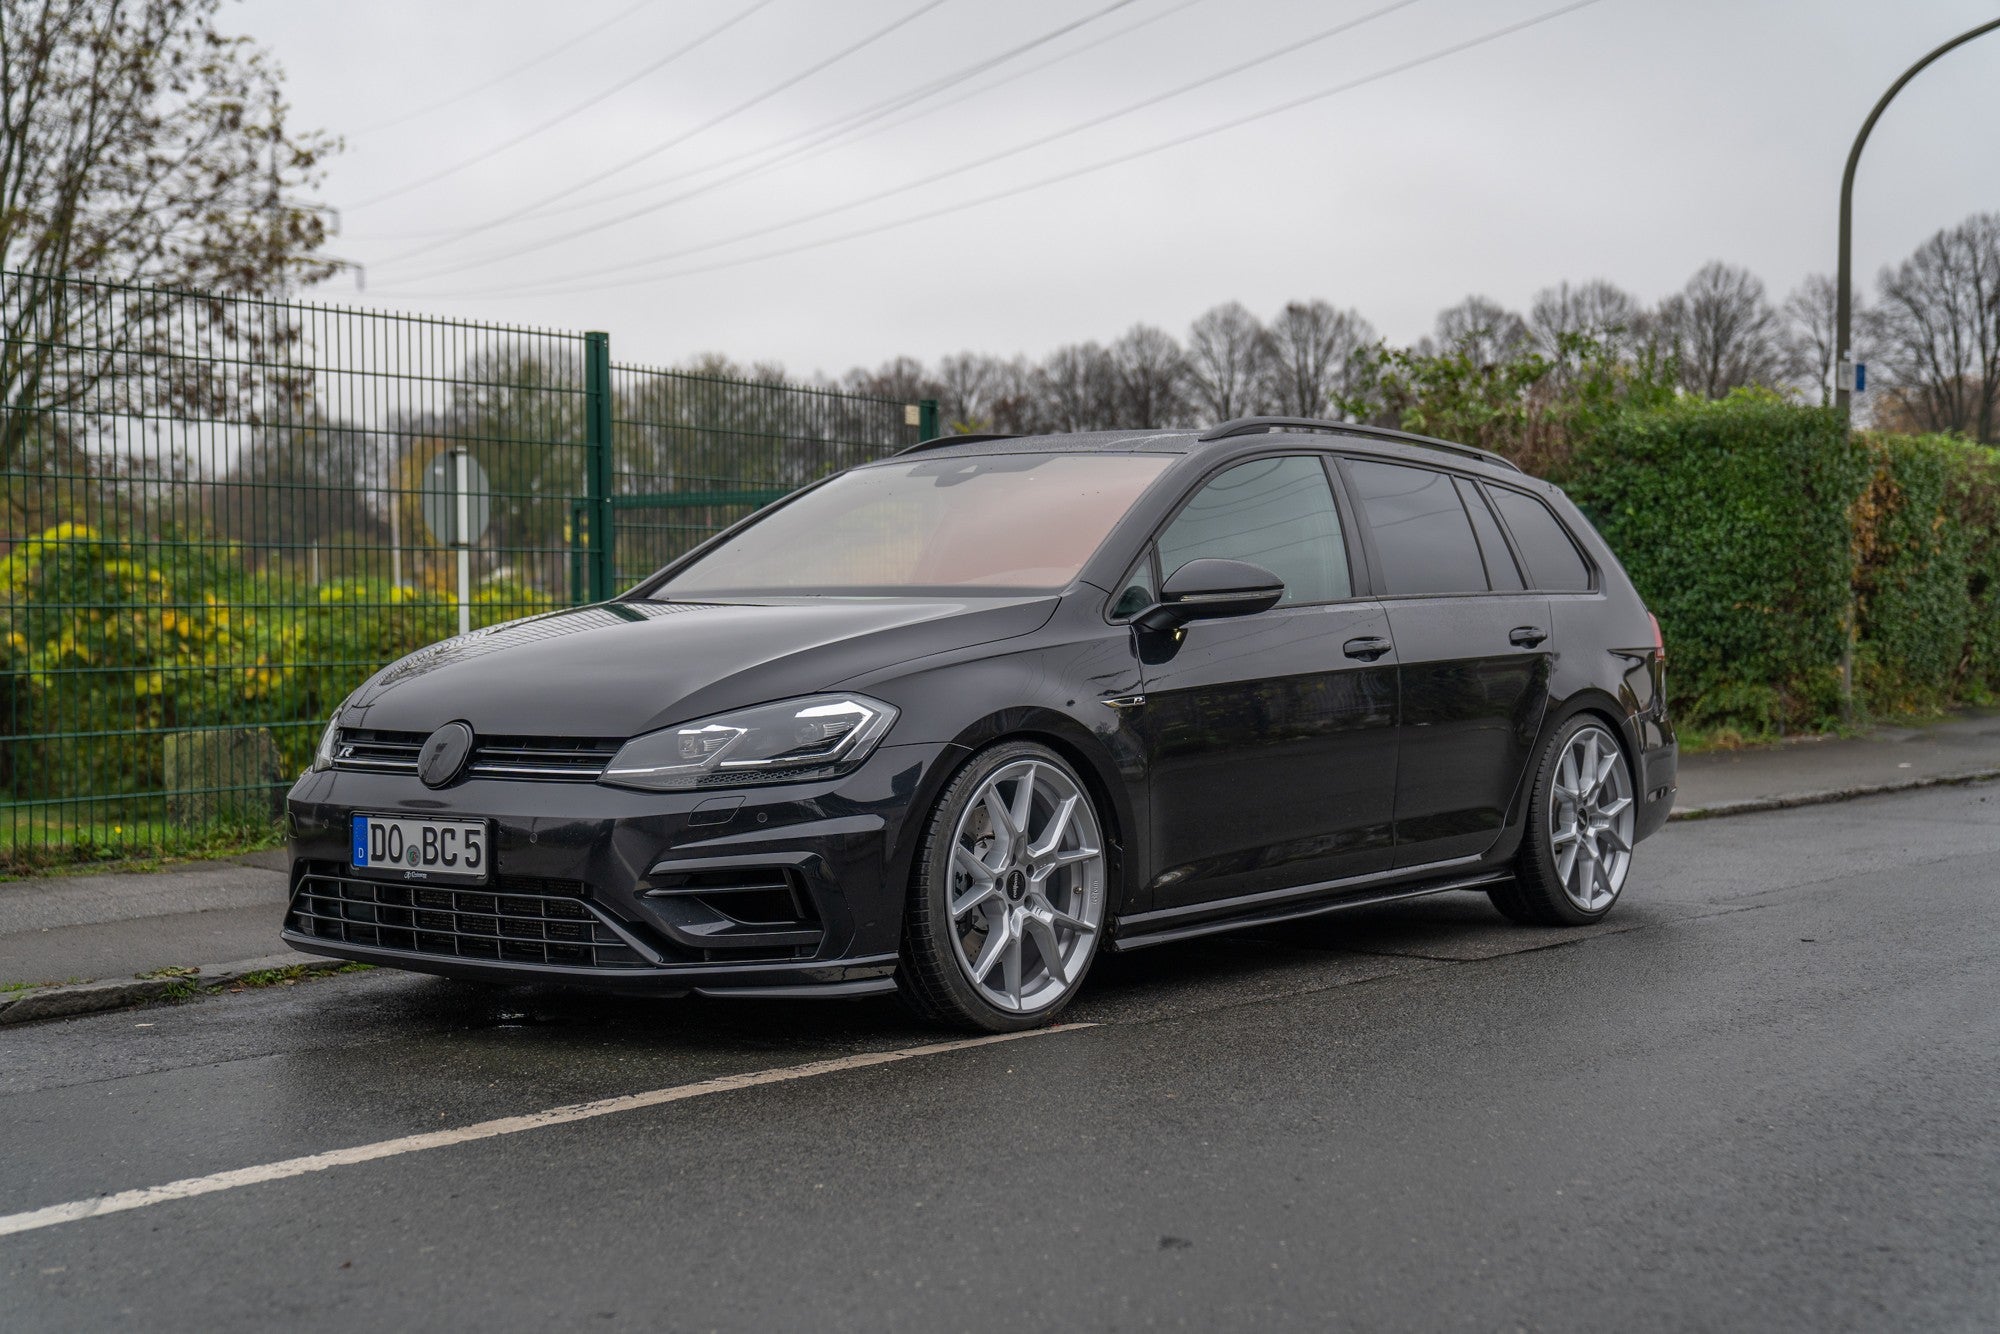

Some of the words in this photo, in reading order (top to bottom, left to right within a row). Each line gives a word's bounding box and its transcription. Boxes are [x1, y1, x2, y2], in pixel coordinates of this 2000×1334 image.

[338, 745, 354, 757] R
[370, 823, 404, 864] DO
[422, 826, 458, 867] BC
[464, 829, 482, 868] 5
[358, 847, 364, 858] D
